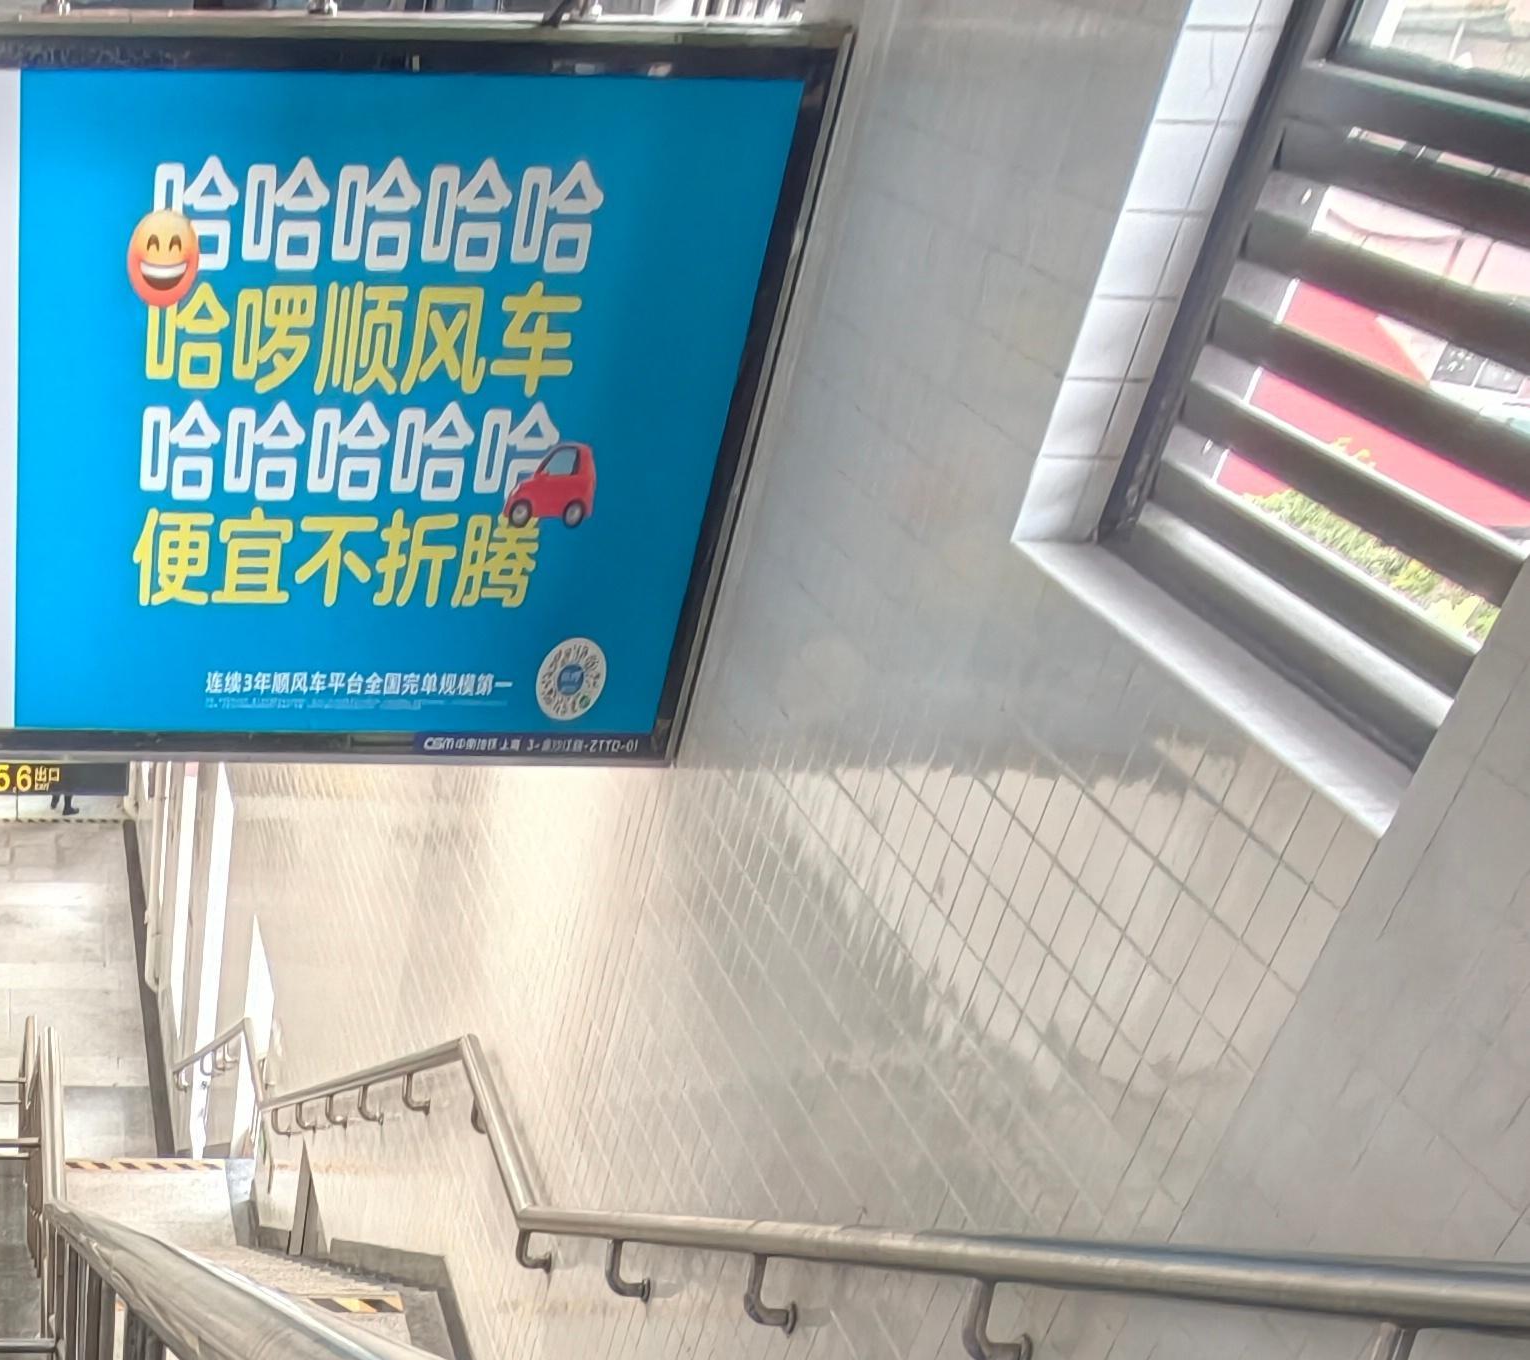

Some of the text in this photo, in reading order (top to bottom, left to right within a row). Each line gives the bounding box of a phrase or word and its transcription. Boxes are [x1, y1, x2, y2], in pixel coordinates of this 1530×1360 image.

[153, 154, 605, 274] 哈哈哈哈哈
[145, 281, 583, 396] 哈啰顺风车
[139, 400, 561, 502] 哈哈哈哈哈
[132, 506, 540, 609] 便宜不折腾
